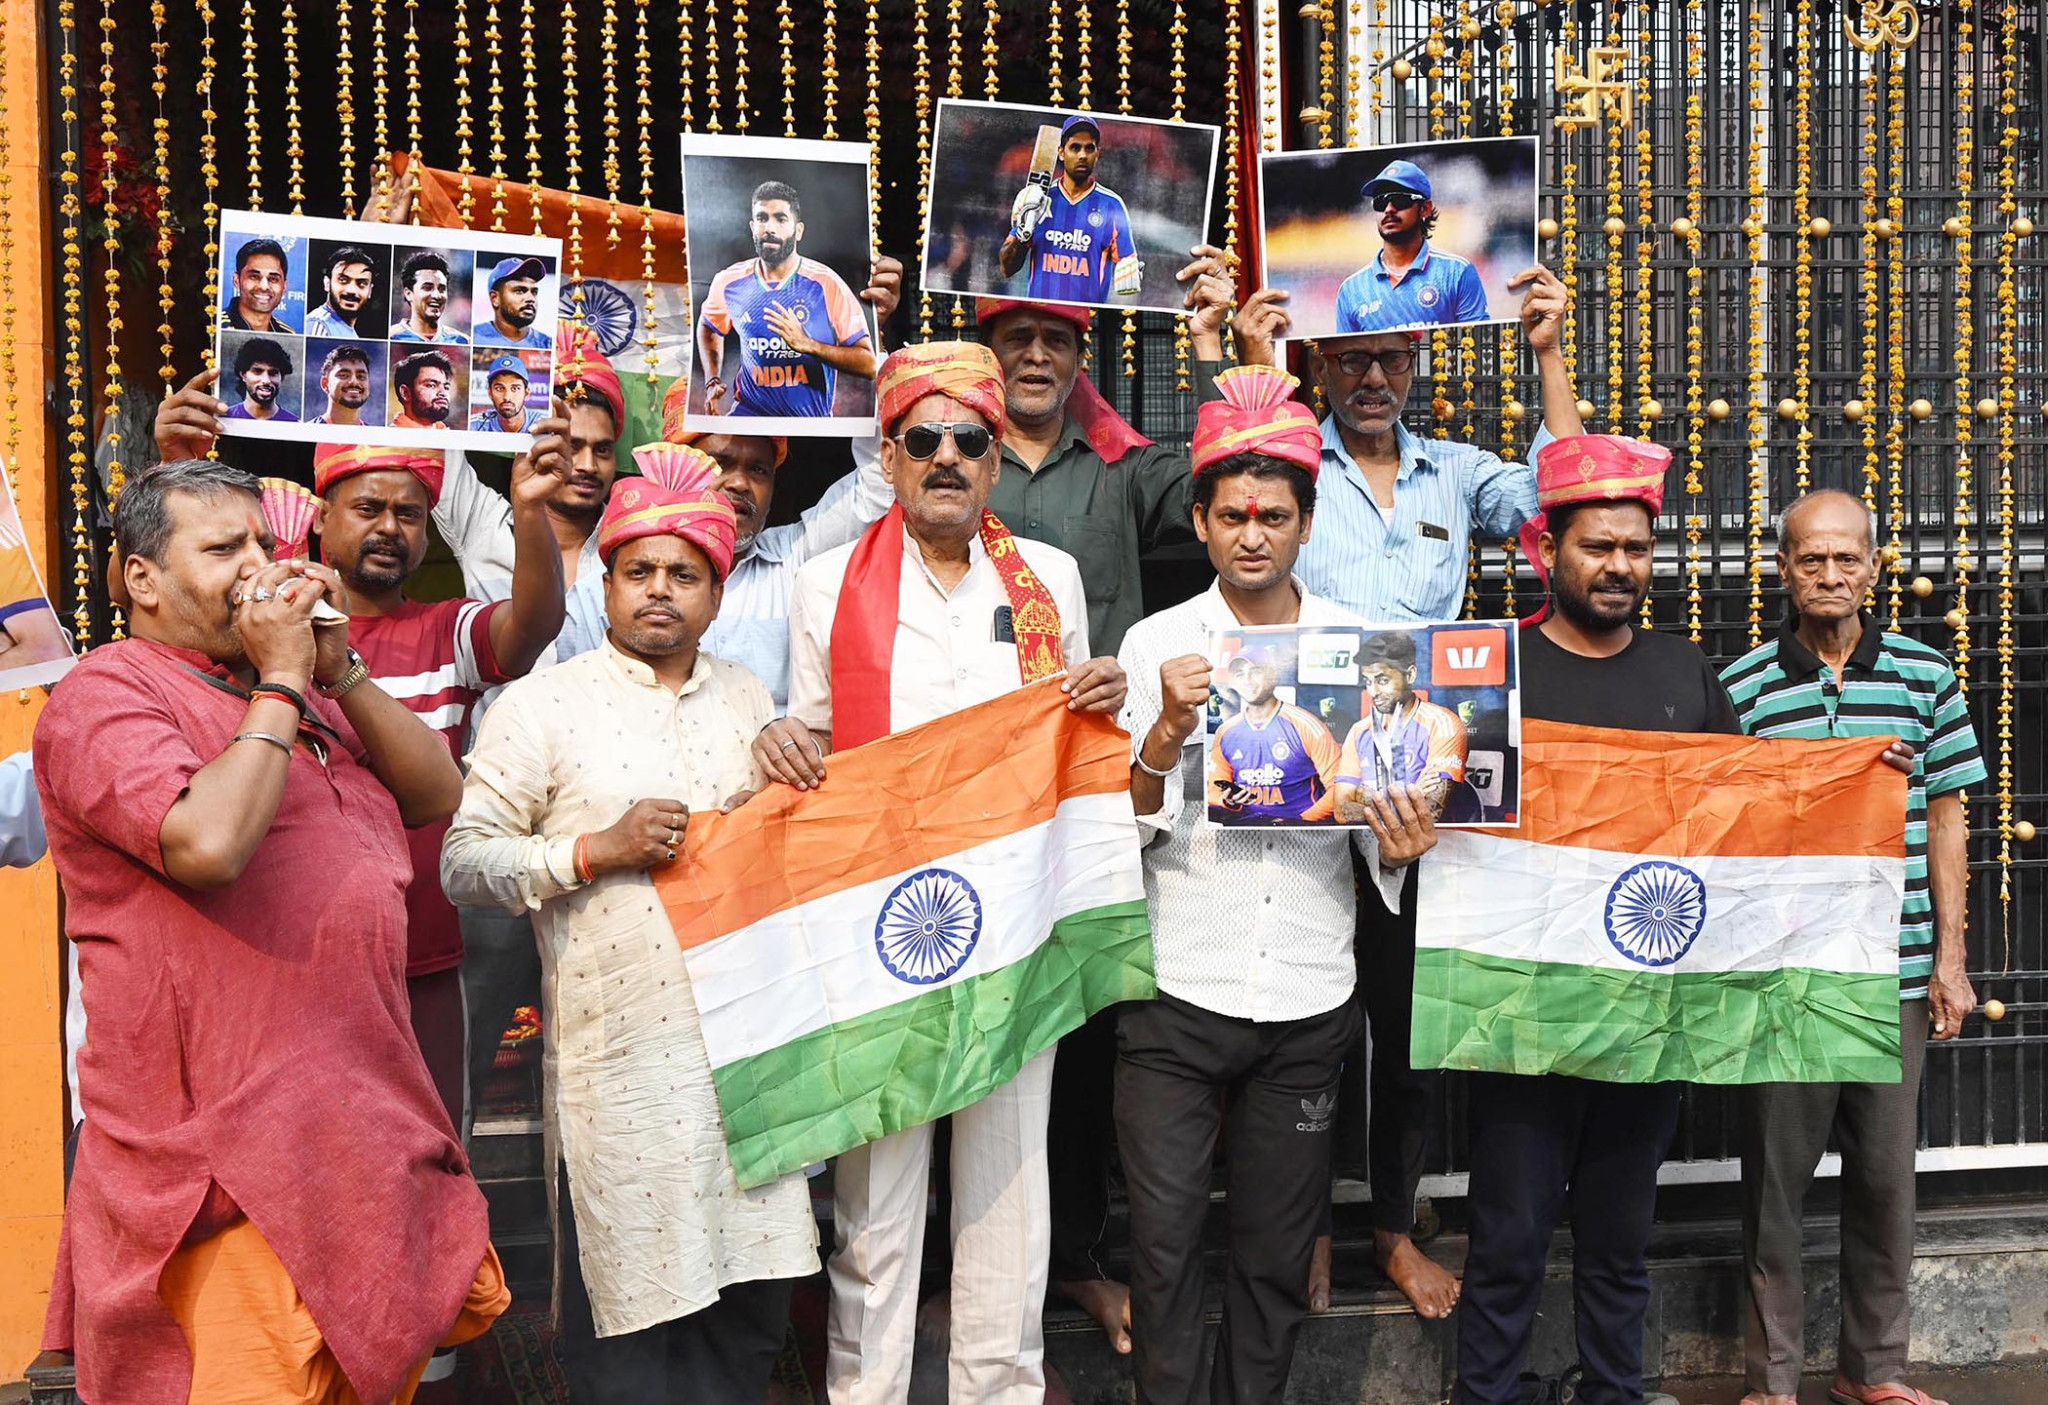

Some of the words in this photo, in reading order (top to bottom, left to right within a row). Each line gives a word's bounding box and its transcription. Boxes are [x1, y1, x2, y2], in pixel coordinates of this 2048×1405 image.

[1045, 229, 1091, 246] apollo
[1042, 253, 1090, 277] INDIA
[749, 337, 792, 356] apol
[751, 364, 809, 388] INDIA
